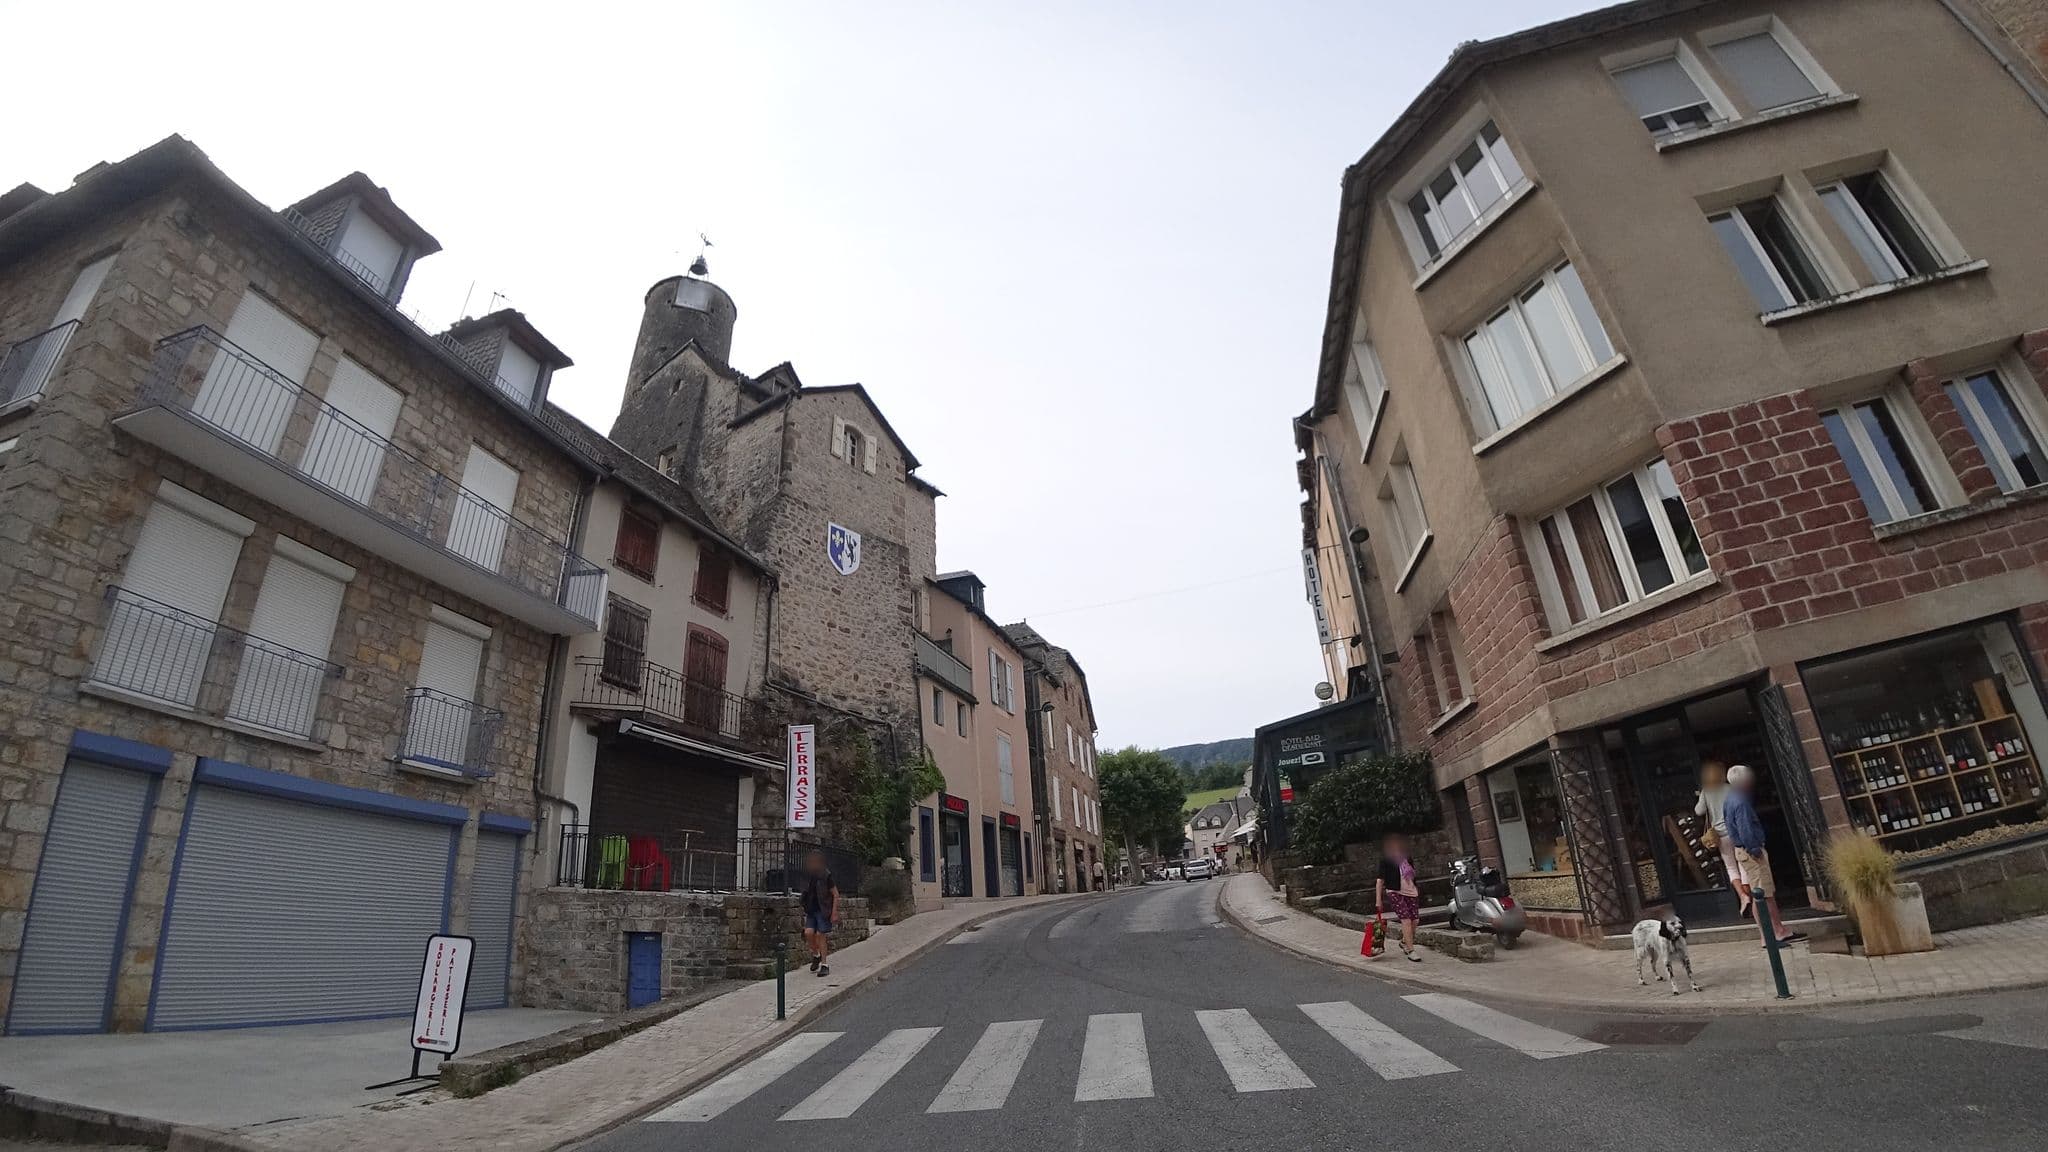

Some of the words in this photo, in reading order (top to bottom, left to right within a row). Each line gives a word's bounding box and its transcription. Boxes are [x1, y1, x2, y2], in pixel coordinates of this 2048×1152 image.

[1305, 554, 1325, 621] HOTEL
[793, 730, 811, 821] TERRASSE
[426, 943, 444, 1036] BOULANGERIE
[439, 948, 456, 1036] PATISSERIE
